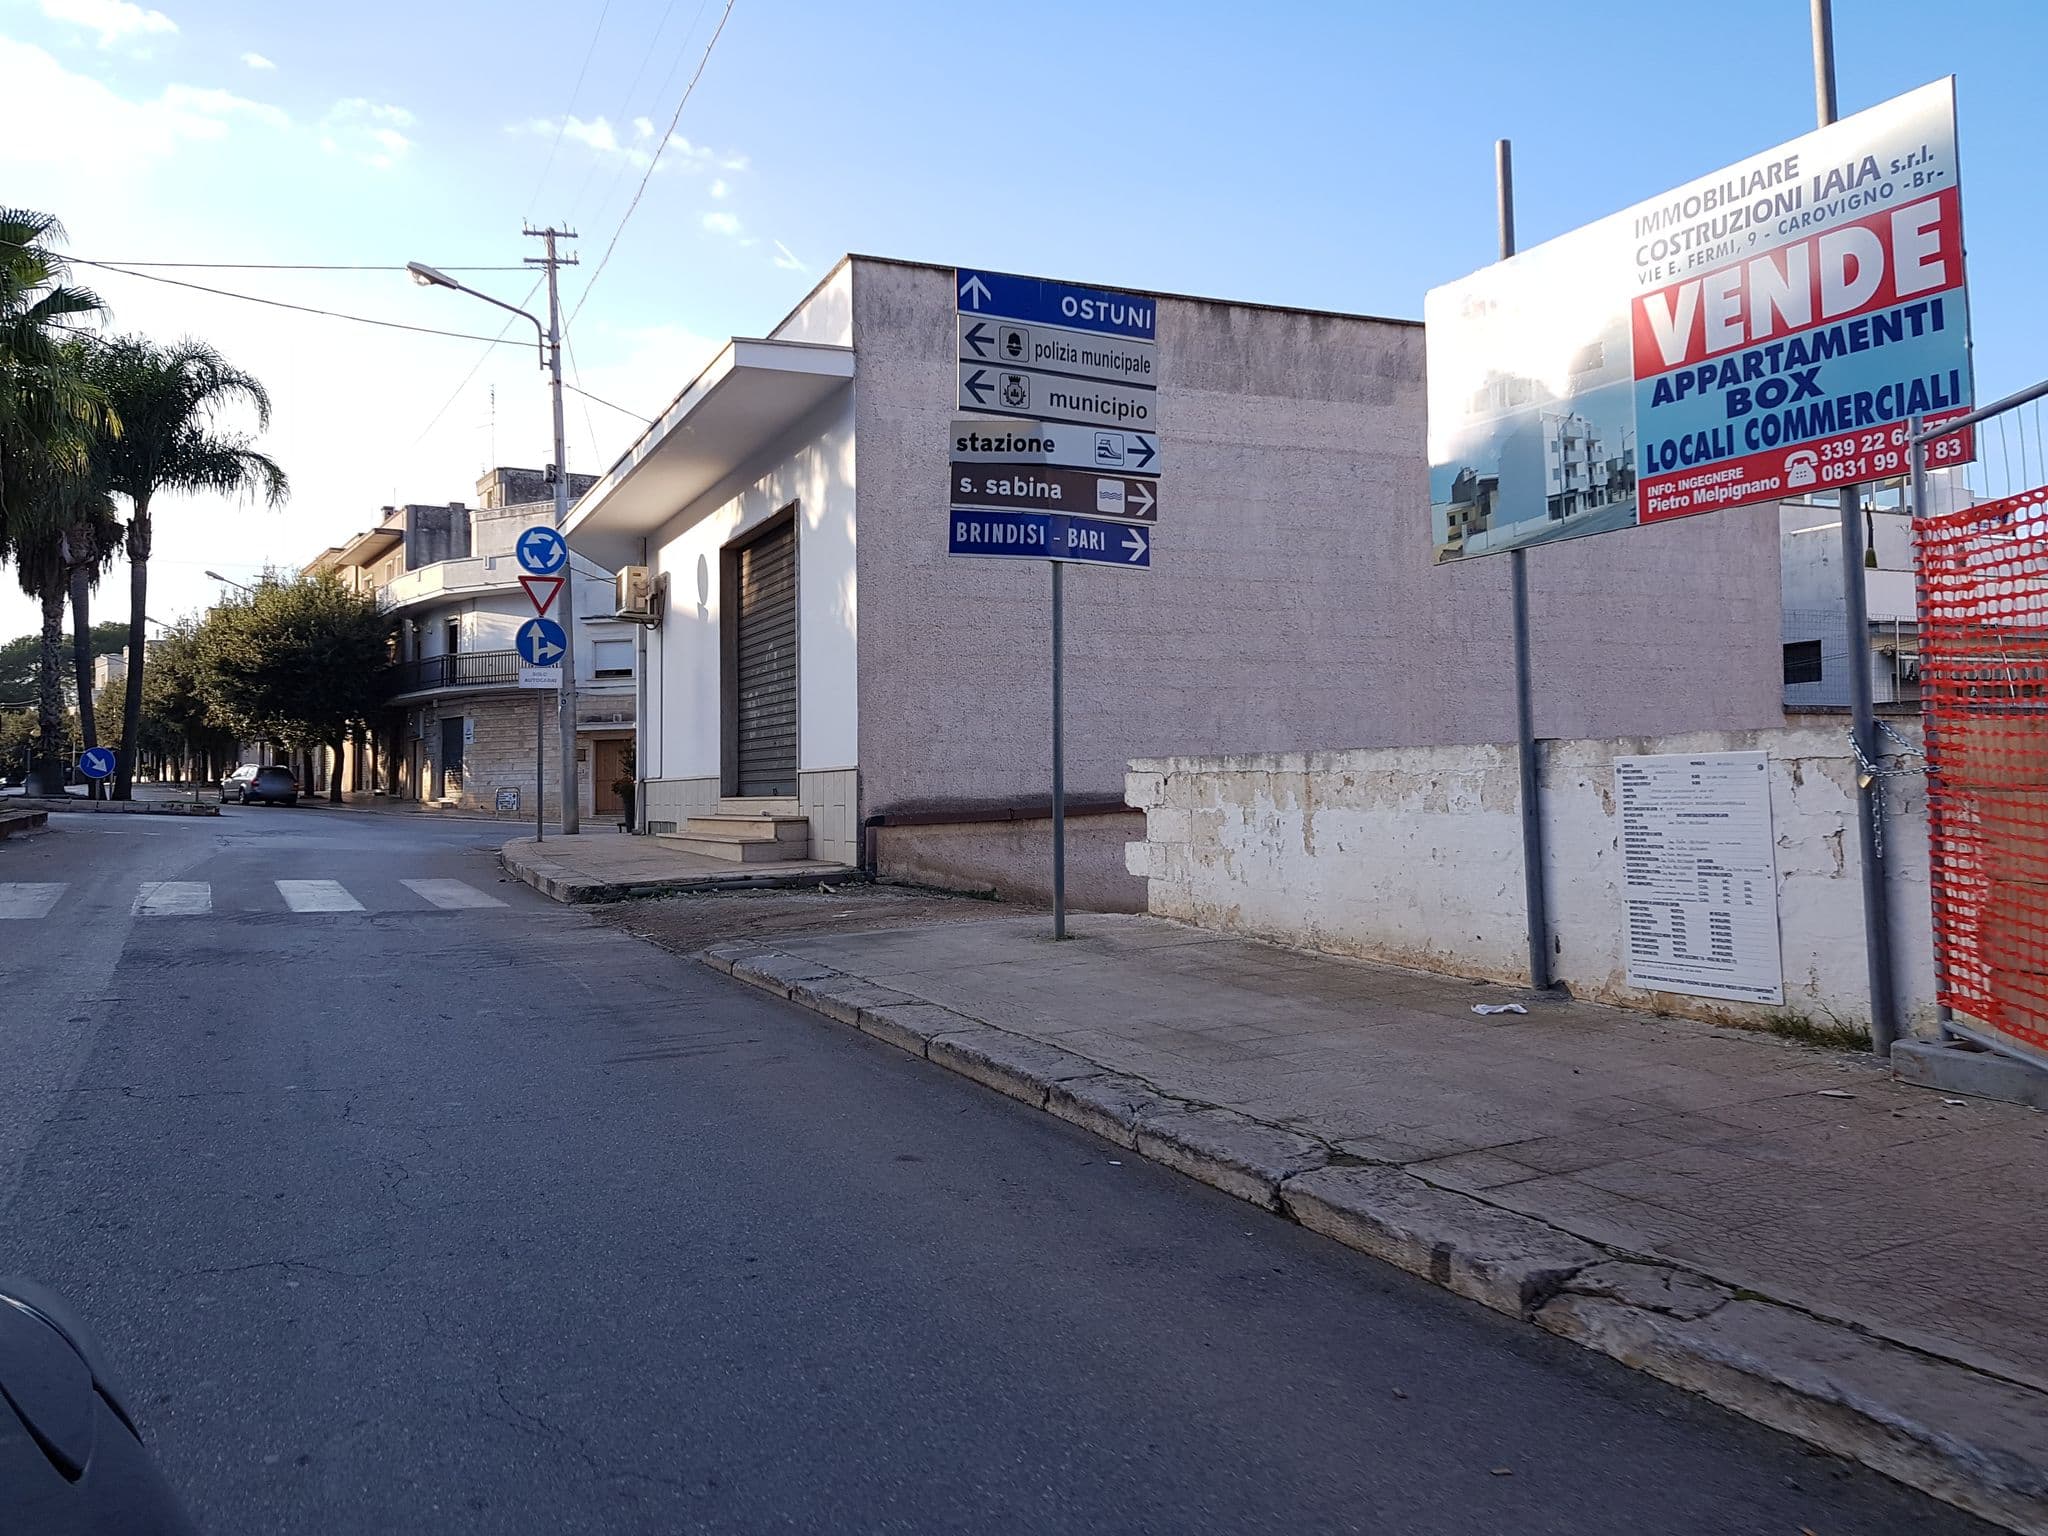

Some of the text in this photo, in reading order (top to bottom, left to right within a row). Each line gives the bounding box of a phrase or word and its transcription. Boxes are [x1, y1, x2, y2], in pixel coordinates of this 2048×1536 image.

[1635, 154, 1800, 239] IMMOBILIARE
[1636, 144, 1935, 266] COSTRUZIONI IAIA s.r.l.
[1668, 260, 1682, 276] E.
[1688, 239, 1742, 269] FERMI,
[1747, 231, 1757, 247] 9
[1778, 182, 1894, 235] CAROVIGNO
[1643, 197, 1948, 367] VENDE
[1061, 295, 1151, 329] OSTUNI
[1034, 340, 1151, 376] polizia municipale
[1651, 298, 1946, 408] APPARTAMENTI
[1049, 391, 1148, 421] municipio
[1726, 365, 1825, 419] BOX
[1646, 368, 1961, 475] LOCALI COMMERCIALI
[956, 432, 1056, 453] stazione
[1820, 438, 1856, 461] 339
[1861, 432, 1886, 454] 22
[1821, 457, 1867, 482] 0831
[1873, 451, 1898, 471] 99
[1935, 438, 1961, 459] 83
[959, 475, 1063, 500] s. sabina
[1647, 467, 1745, 498] INFO: INGEGNERE
[1647, 476, 1781, 514] Pietro Melpignano
[956, 522, 1045, 546] BRINDISI
[1067, 527, 1106, 552] BARI
